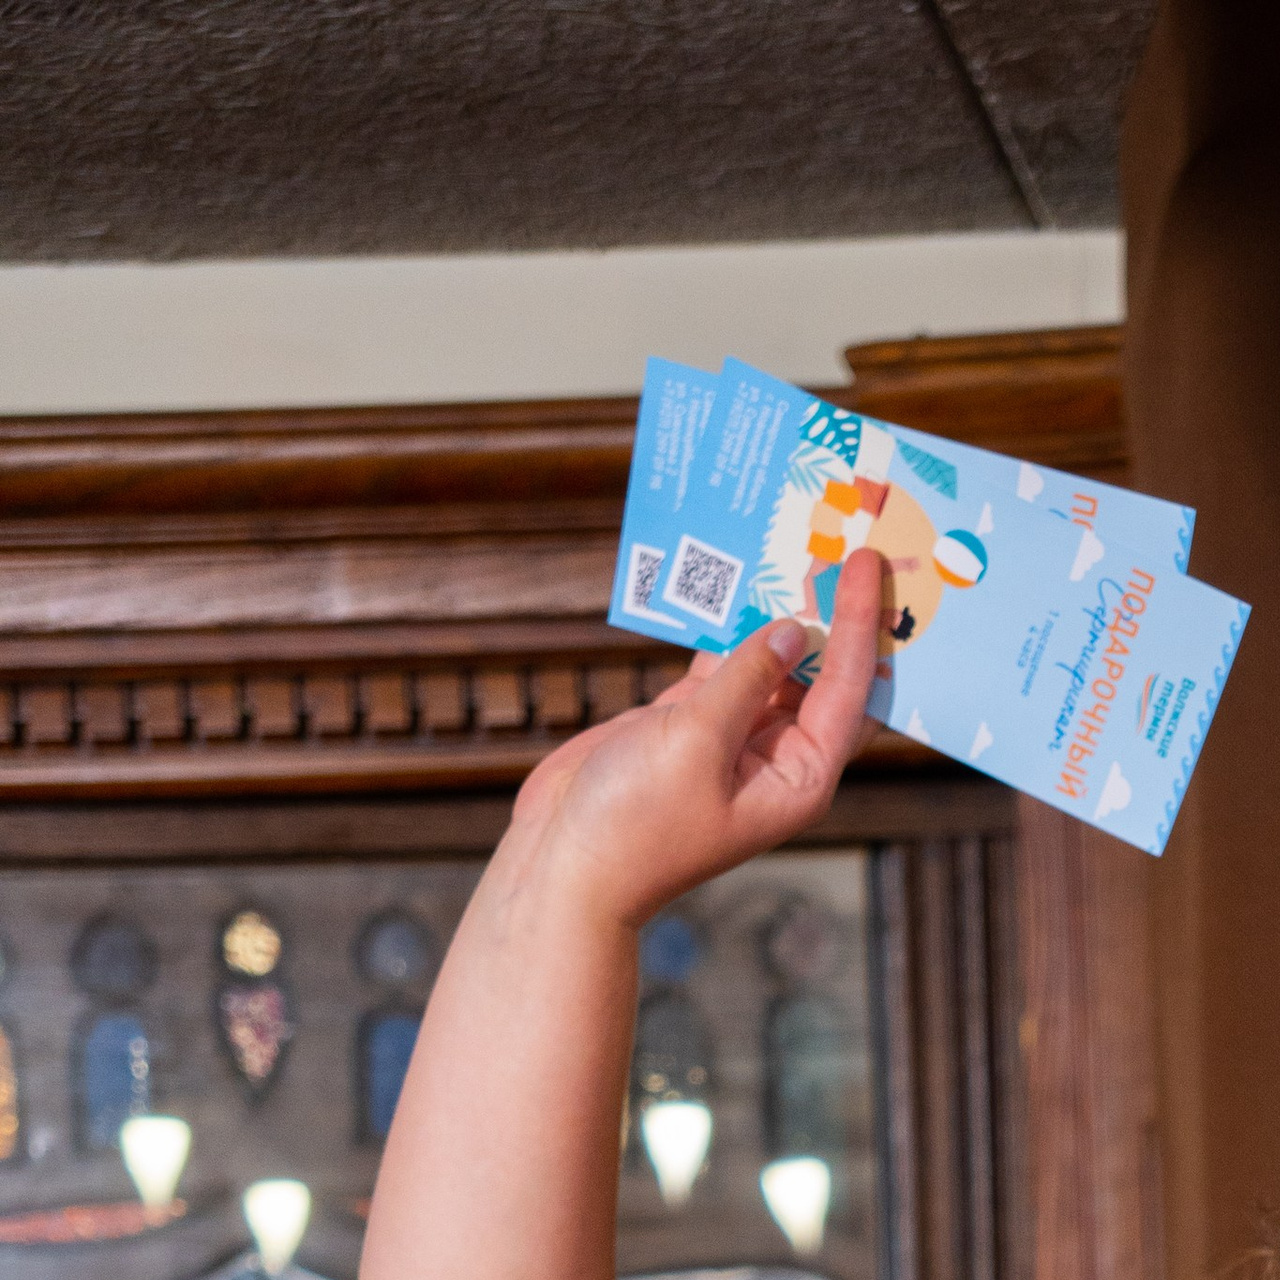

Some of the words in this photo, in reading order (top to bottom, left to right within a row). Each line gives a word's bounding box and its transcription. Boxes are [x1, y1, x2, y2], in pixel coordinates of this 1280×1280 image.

[1048, 577, 1134, 751] Сертификат
[1055, 566, 1157, 799] ПОДАРОЧНЫЙ
[1145, 680, 1175, 742] термы
[1157, 677, 1197, 759] Волжские
